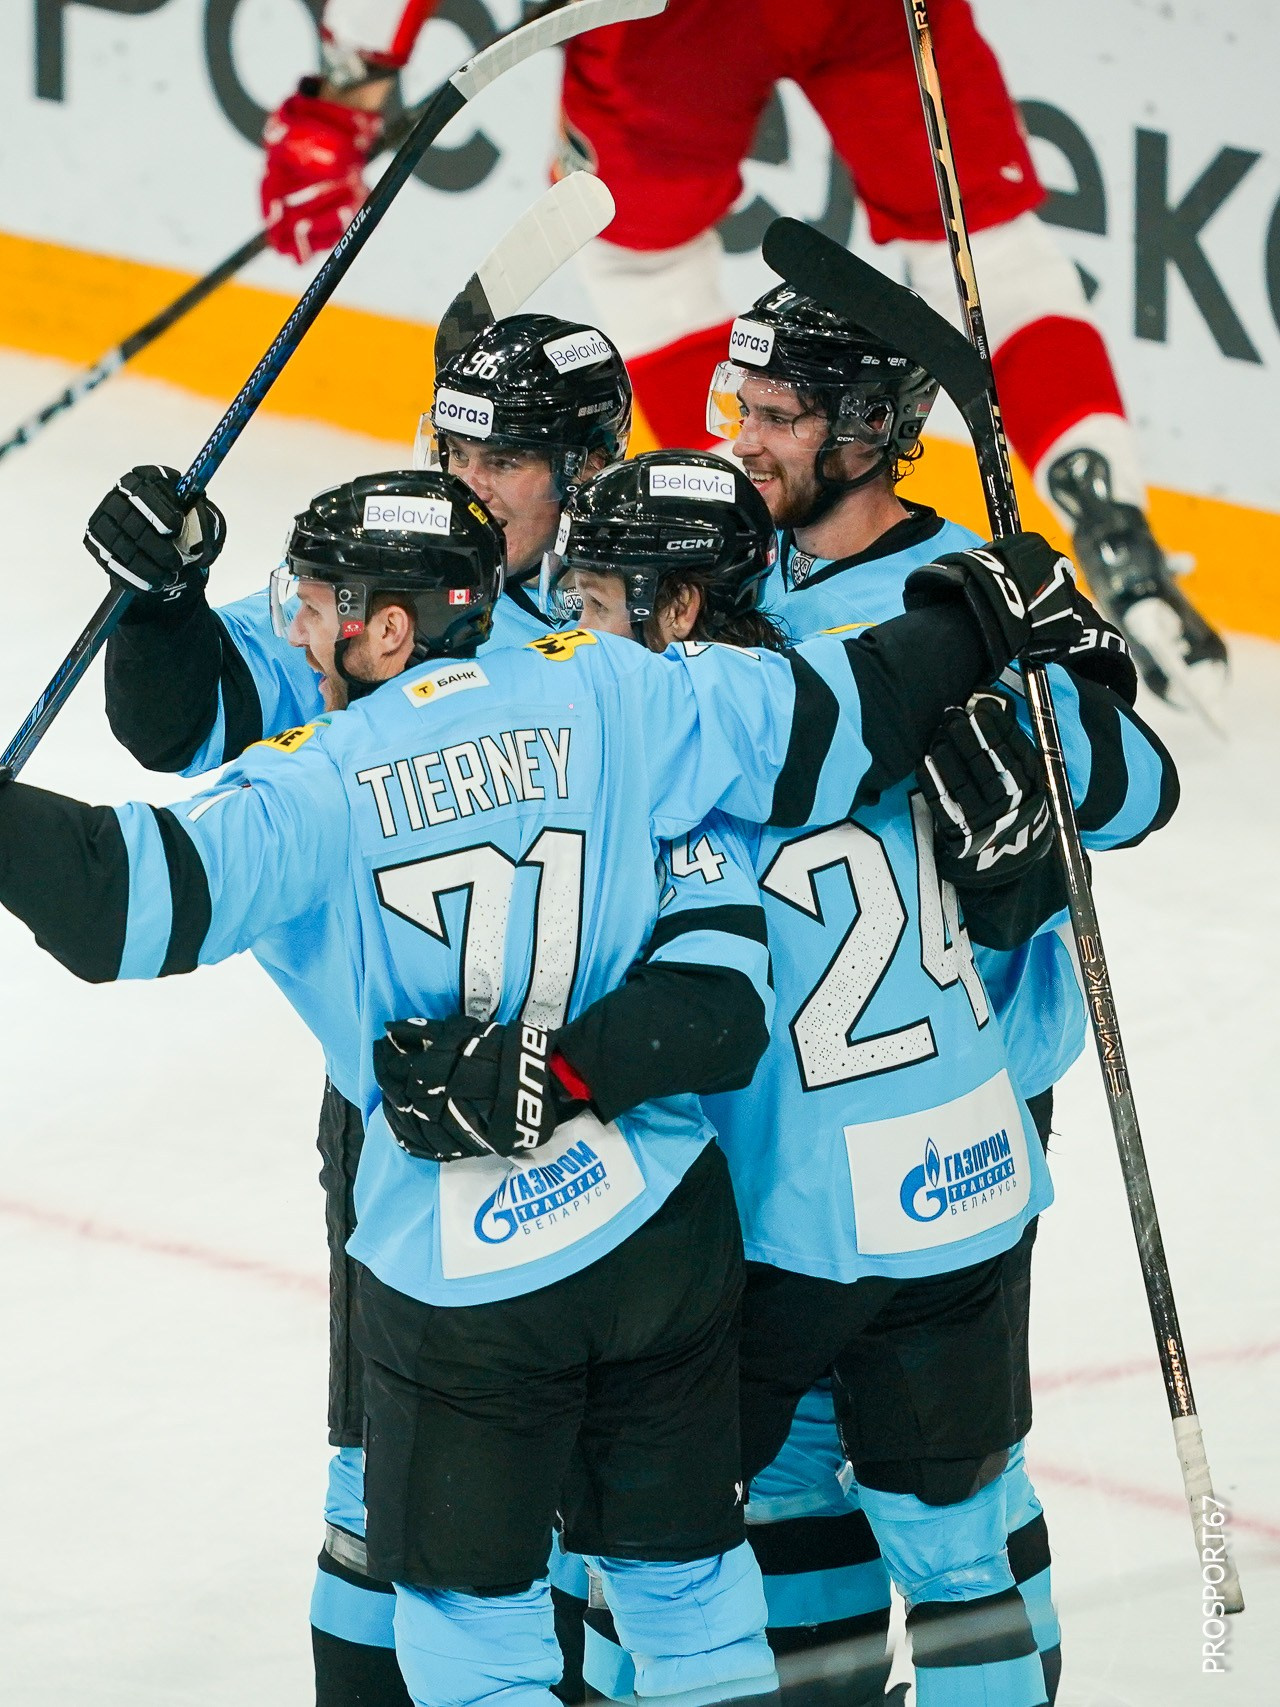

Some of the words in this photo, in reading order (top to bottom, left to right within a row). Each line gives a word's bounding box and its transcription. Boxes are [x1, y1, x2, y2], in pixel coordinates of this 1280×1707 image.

[334, 208, 368, 259] SOYUZ
[463, 350, 505, 380] 96
[549, 336, 612, 367] Belavia
[437, 400, 489, 426] согаз
[651, 473, 733, 496] Belavia
[365, 504, 448, 529] Belavia
[666, 537, 714, 550] CCM
[437, 671, 477, 687] БАНК
[357, 727, 572, 838] TIERNEY
[372, 827, 587, 1030] 71
[760, 790, 990, 1093] 24
[1080, 933, 1130, 1097] SMOKE
[510, 1139, 598, 1204] ГАЗПРОМ
[944, 1129, 1011, 1183] ГАЗПРОМ
[519, 1164, 605, 1220] ТРАНСГАЗ
[950, 1178, 1018, 1216] БЕЛАРУСЬ
[951, 1160, 1014, 1200] ТРАНСГАЗ
[522, 1180, 612, 1236] БЕЛАРУСЬ
